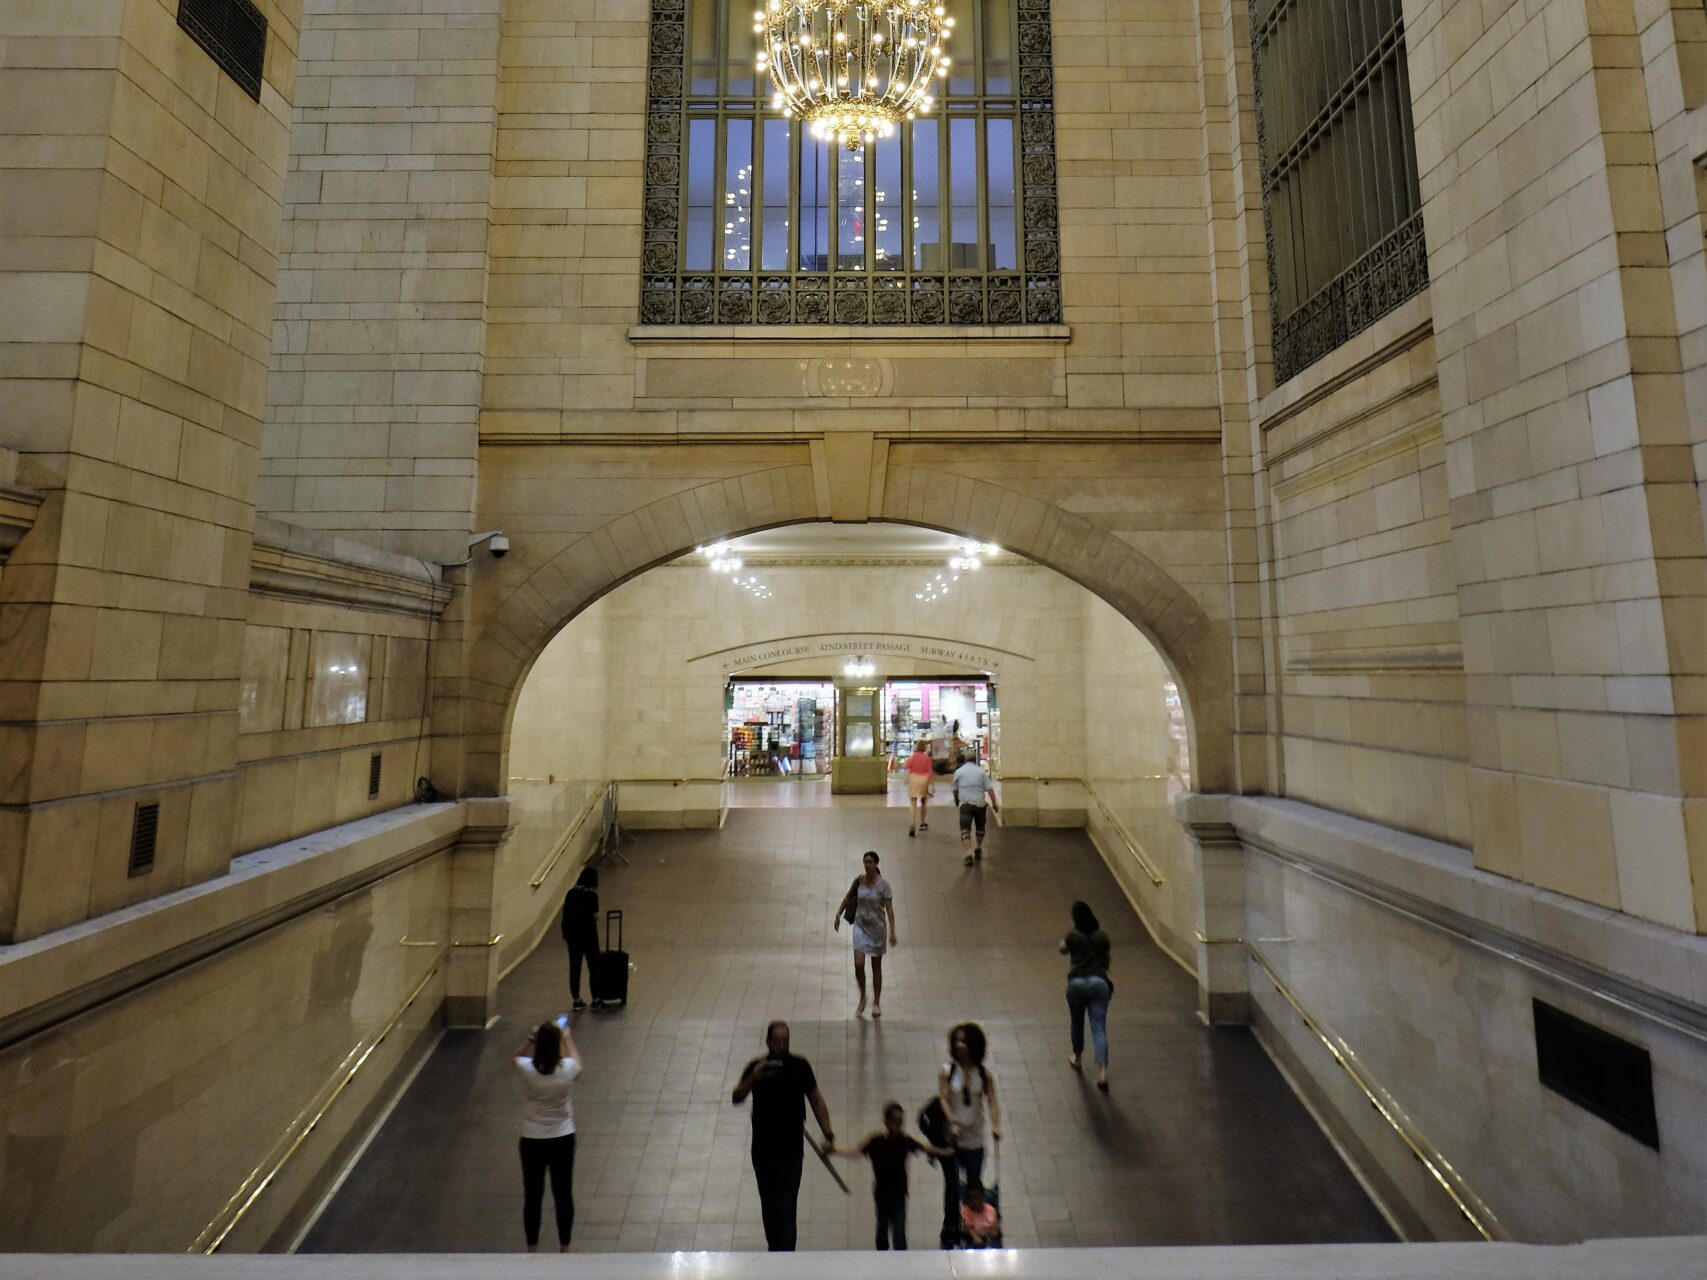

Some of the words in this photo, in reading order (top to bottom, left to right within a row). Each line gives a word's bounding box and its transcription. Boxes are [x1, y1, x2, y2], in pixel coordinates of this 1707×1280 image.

[820, 643, 842, 652] 42ND
[843, 642, 874, 651] STREET
[876, 642, 911, 652] PASSAGE
[921, 646, 956, 658] SUBWAY
[734, 656, 758, 666] MAIN
[758, 646, 810, 660] CONCOURSE
